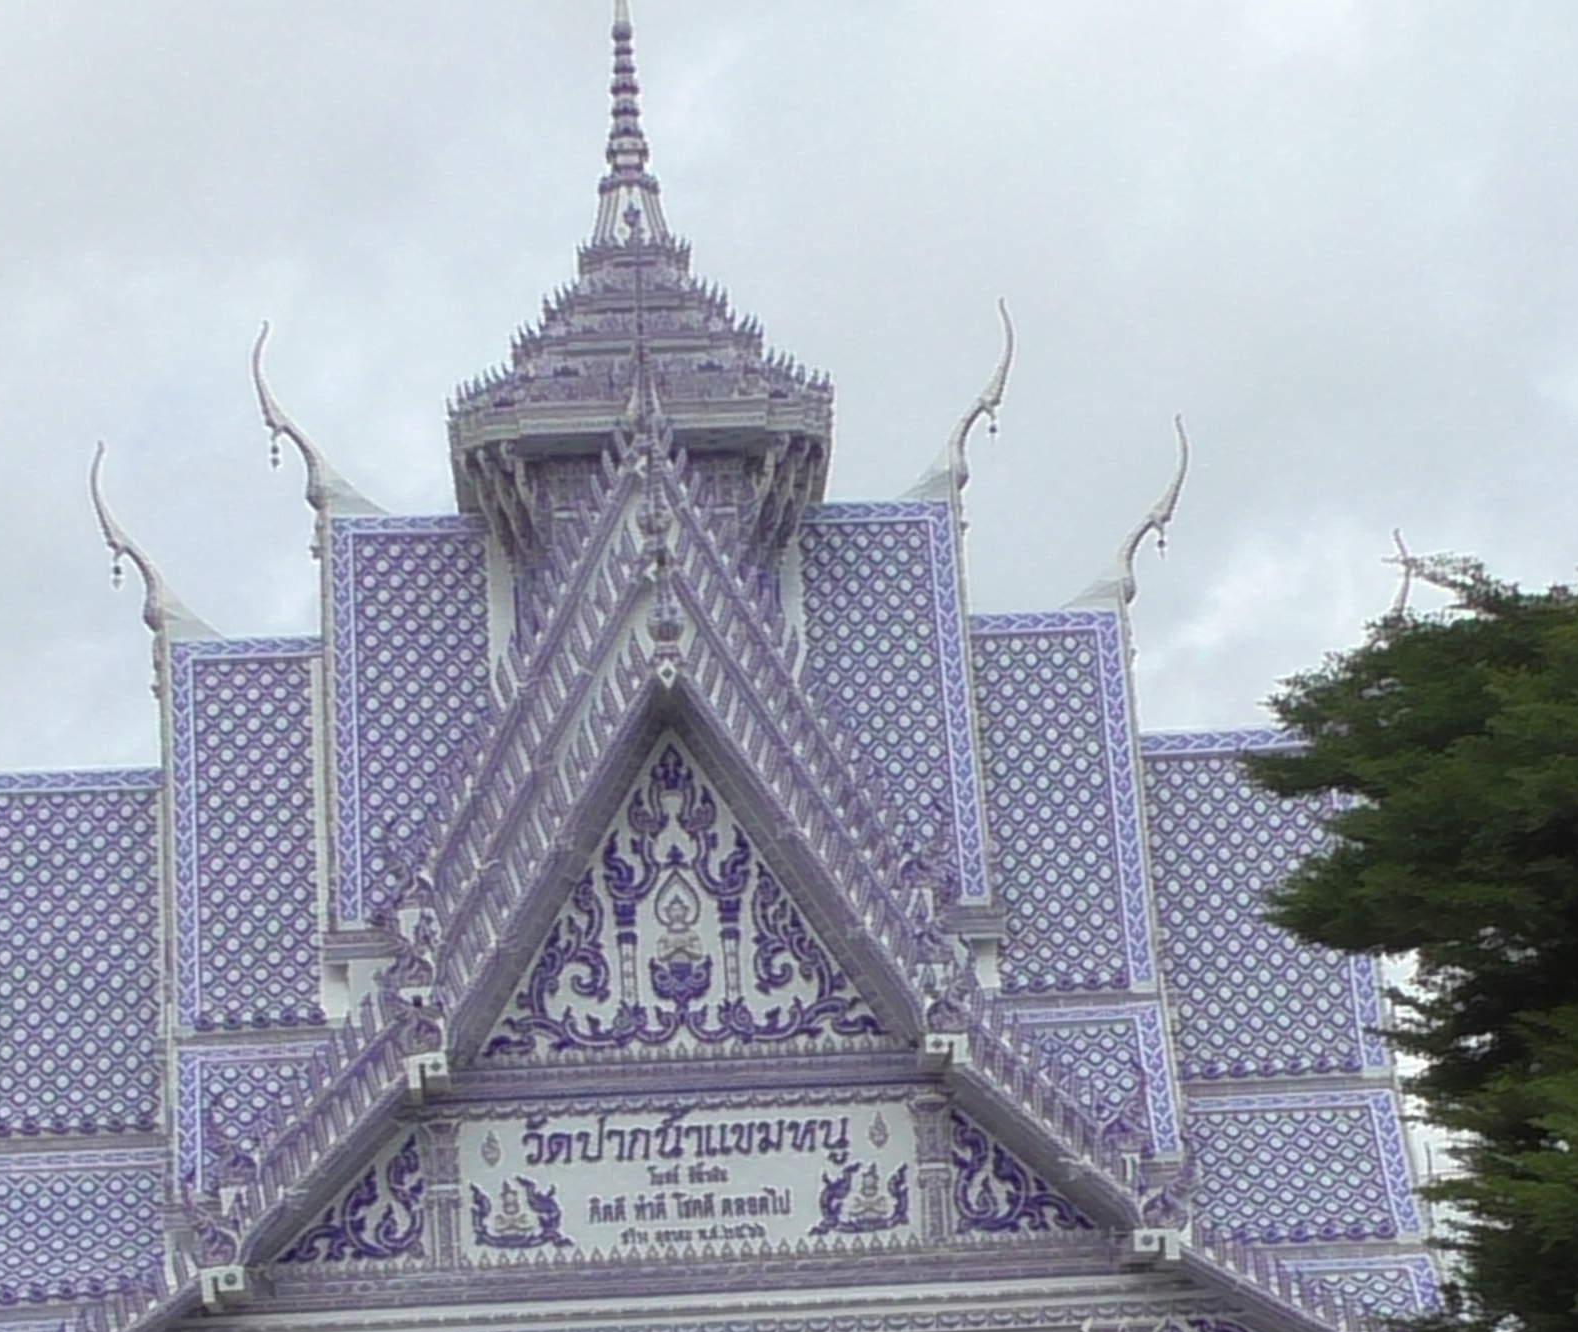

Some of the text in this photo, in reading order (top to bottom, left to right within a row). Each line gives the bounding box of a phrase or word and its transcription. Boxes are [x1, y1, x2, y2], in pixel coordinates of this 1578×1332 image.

[522, 1107, 849, 1165] วัดปากน้ำแขมหนู
